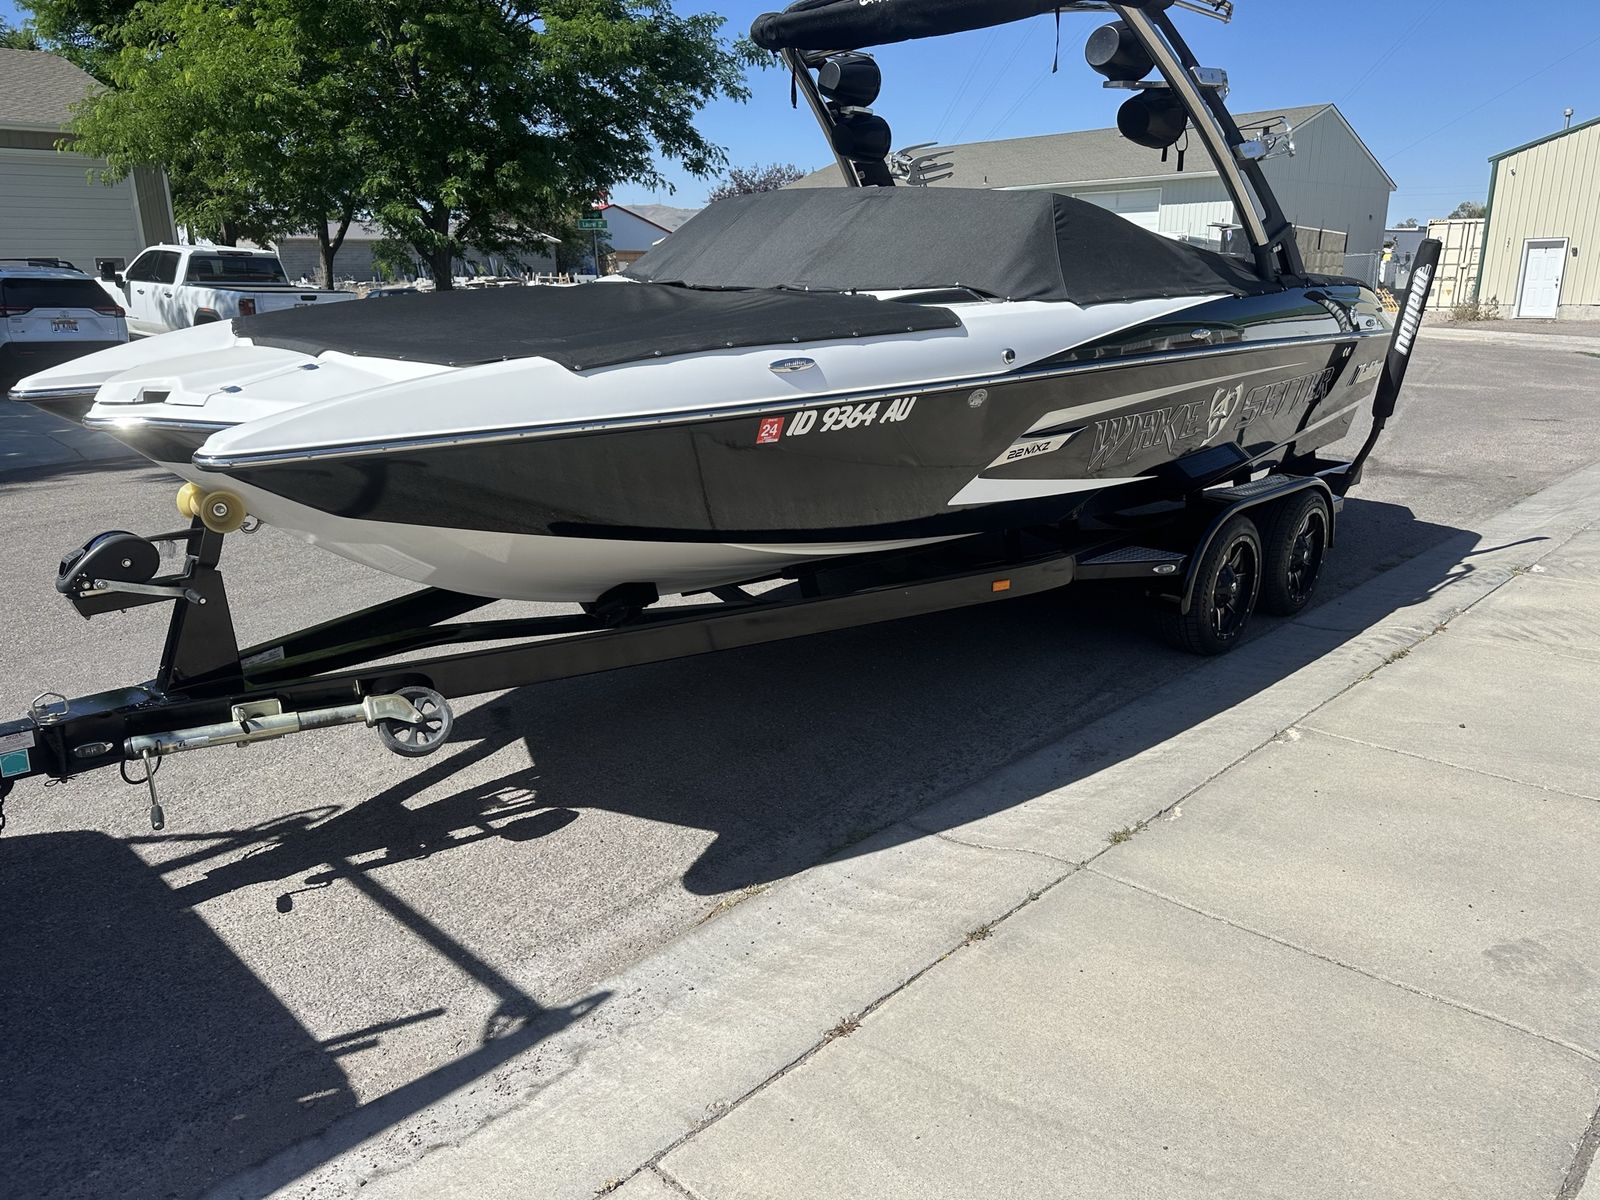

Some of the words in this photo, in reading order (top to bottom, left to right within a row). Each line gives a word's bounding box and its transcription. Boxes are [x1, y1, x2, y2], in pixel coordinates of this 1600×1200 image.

[1394, 263, 1433, 356] malibu
[760, 424, 778, 437] 24
[786, 410, 818, 437] ID
[819, 401, 880, 432] 9364
[880, 396, 917, 424] AU
[1087, 400, 1206, 472] WAKE
[1234, 367, 1336, 430] SETTER
